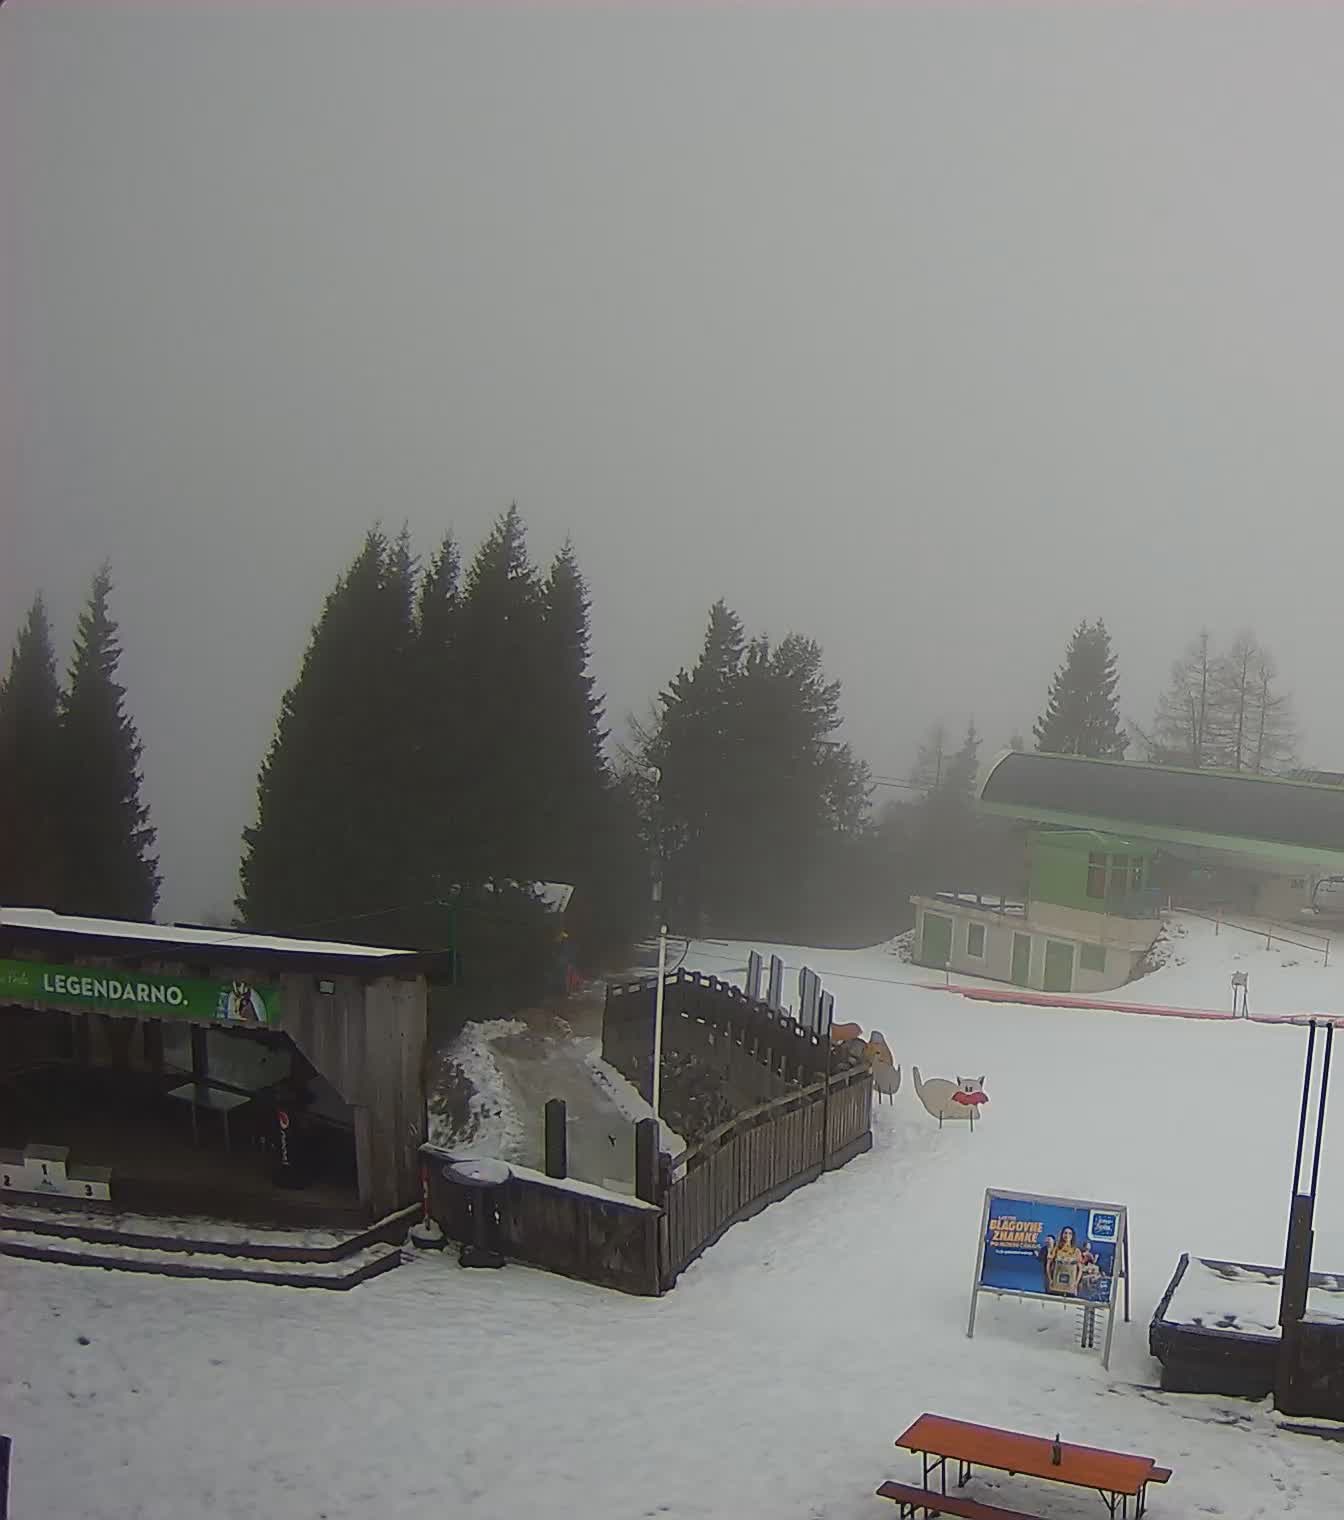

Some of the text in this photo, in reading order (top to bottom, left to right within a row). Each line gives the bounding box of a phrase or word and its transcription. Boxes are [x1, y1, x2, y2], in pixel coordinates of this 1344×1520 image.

[43, 973, 189, 1006] LEGENDARNO.
[41, 1163, 48, 1176] 1
[3, 1174, 12, 1187] 2
[84, 1184, 94, 1197] 3
[990, 1219, 1044, 1233] BLAGOVNE
[992, 1230, 1039, 1243] ZNAMKE
